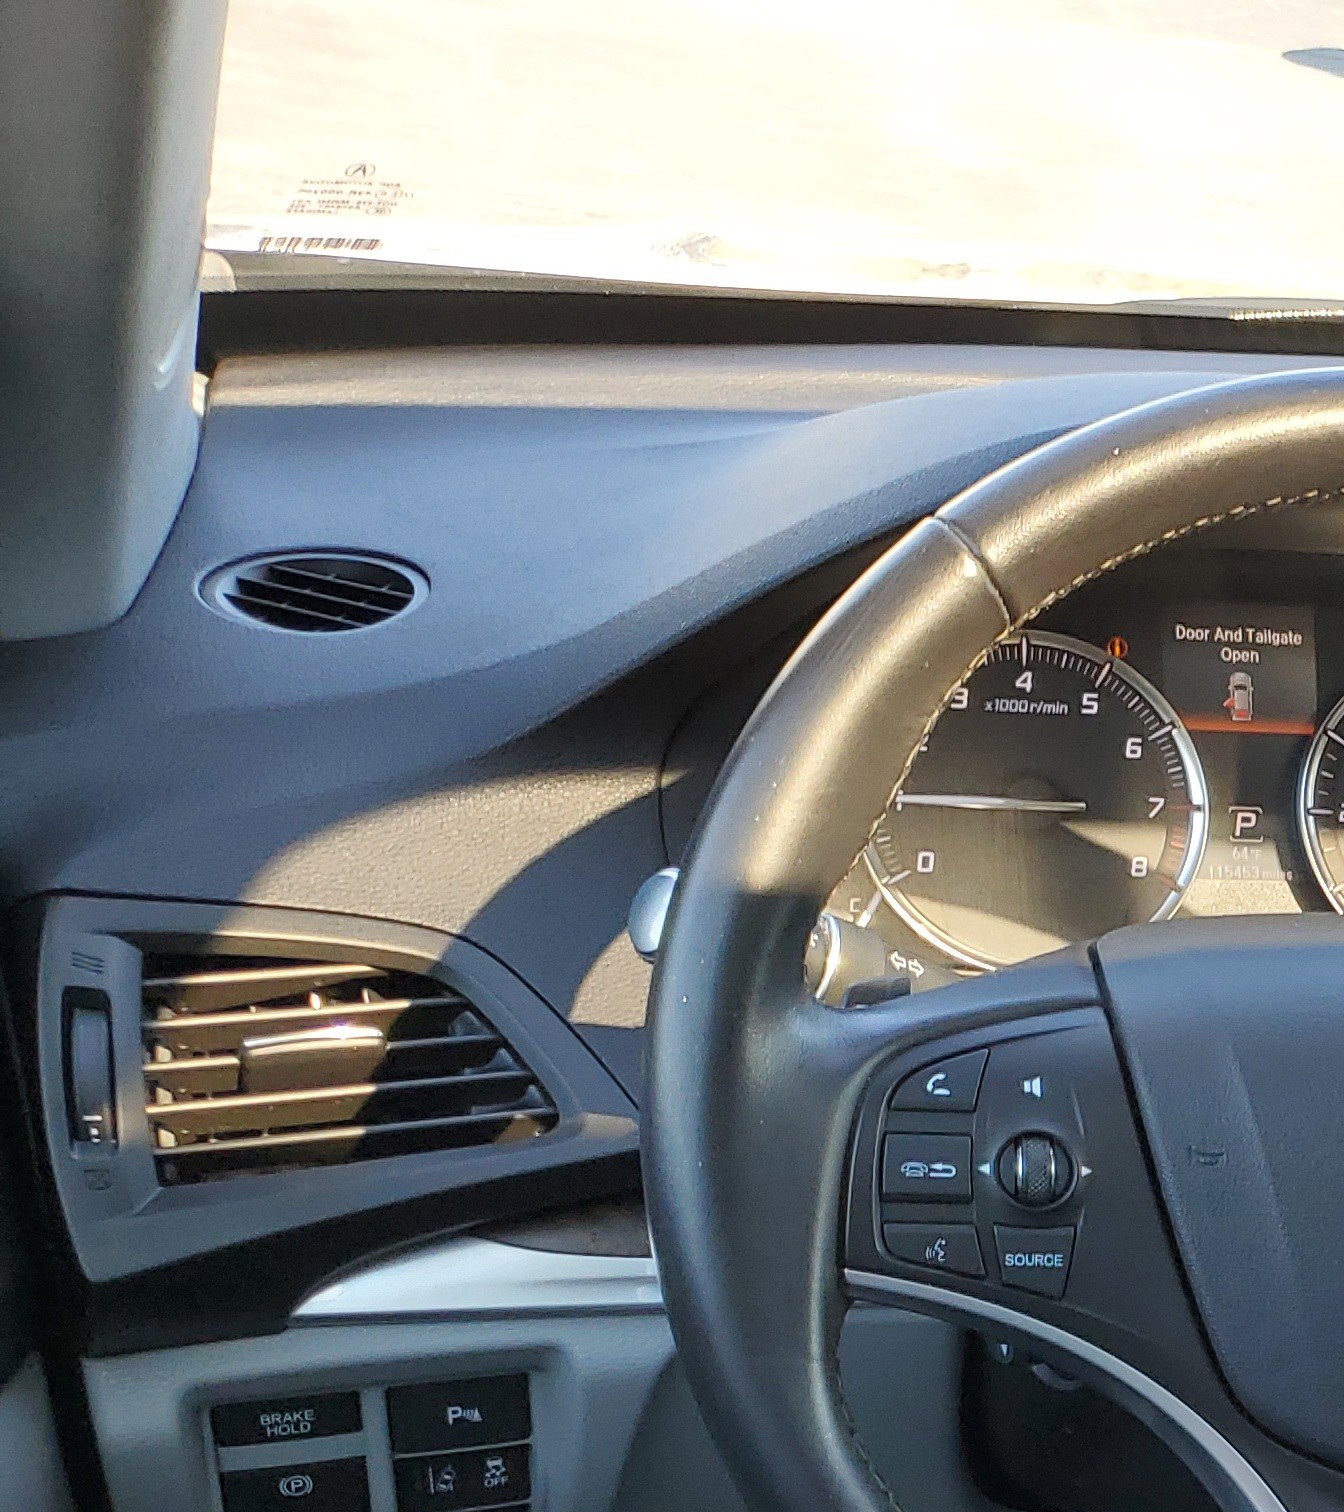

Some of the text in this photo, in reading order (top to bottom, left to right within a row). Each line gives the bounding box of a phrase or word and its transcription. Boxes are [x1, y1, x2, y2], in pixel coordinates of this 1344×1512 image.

[1175, 622, 1303, 647] Door And Tailgate
[1219, 646, 1260, 665] Open
[1015, 670, 1033, 694] 4
[951, 687, 969, 710] 3
[1080, 692, 1100, 715] 5
[1125, 737, 1143, 760] 6
[1147, 797, 1165, 820] 7
[1234, 811, 1256, 837] P
[917, 850, 935, 874] 0
[1130, 855, 1149, 878] 8
[850, 897, 862, 912] C
[1004, 1253, 1064, 1268] SOURCE
[260, 1408, 316, 1427] BRAKE
[265, 1421, 311, 1438] HOLD
[484, 1475, 510, 1488] OFF
